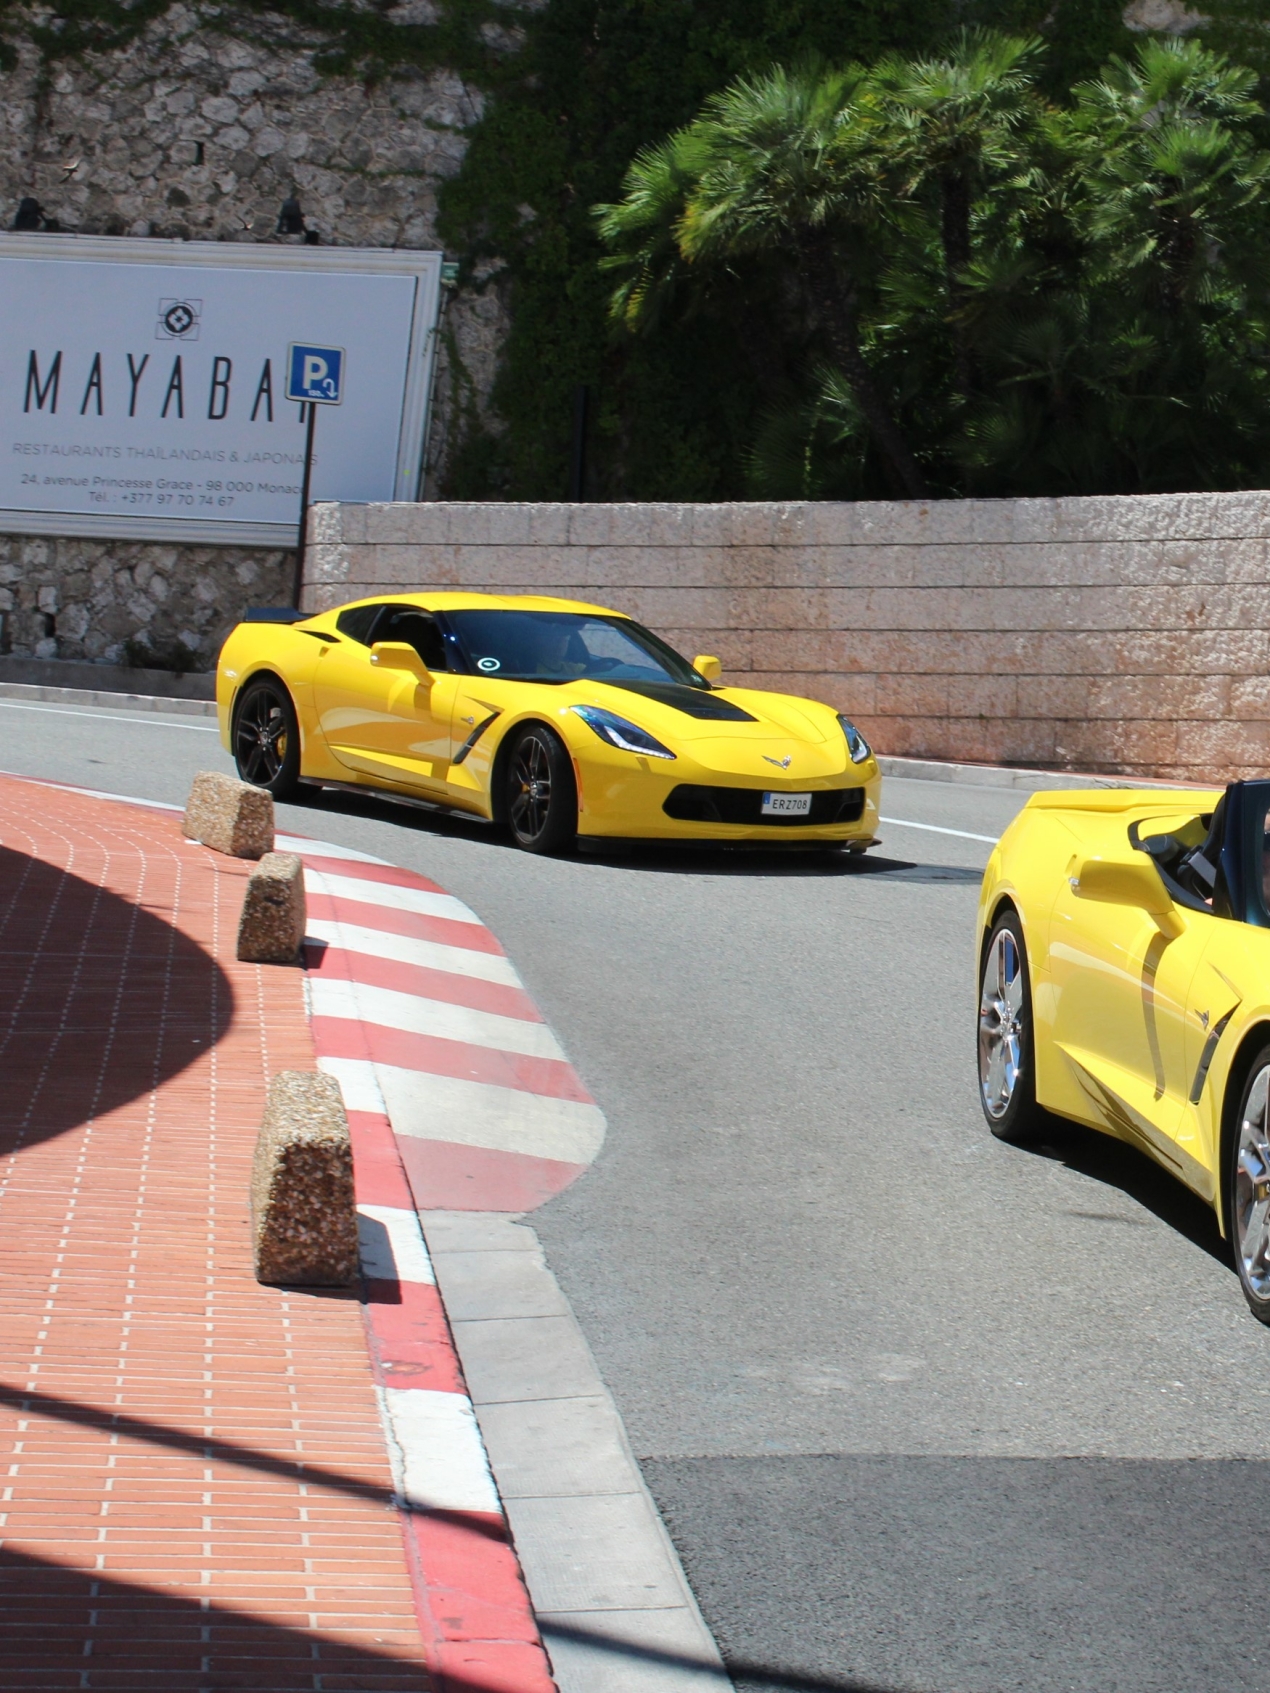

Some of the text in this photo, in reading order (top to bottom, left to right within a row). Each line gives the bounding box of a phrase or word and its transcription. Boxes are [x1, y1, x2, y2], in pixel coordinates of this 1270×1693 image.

[302, 354, 329, 390] P
[12, 443, 121, 459] RESTAURANTS
[229, 451, 239, 463] &
[244, 452, 318, 466] JAPONAS
[21, 473, 40, 486] 24,
[43, 476, 89, 486] avenue
[93, 476, 153, 489] Princesse
[156, 478, 194, 490] Grace
[206, 480, 223, 491] 98
[226, 481, 254, 492] 000
[122, 493, 153, 503] +377
[157, 493, 173, 504] 97
[178, 494, 194, 505] 70
[200, 495, 214, 505] 74
[218, 496, 234, 506] 67
